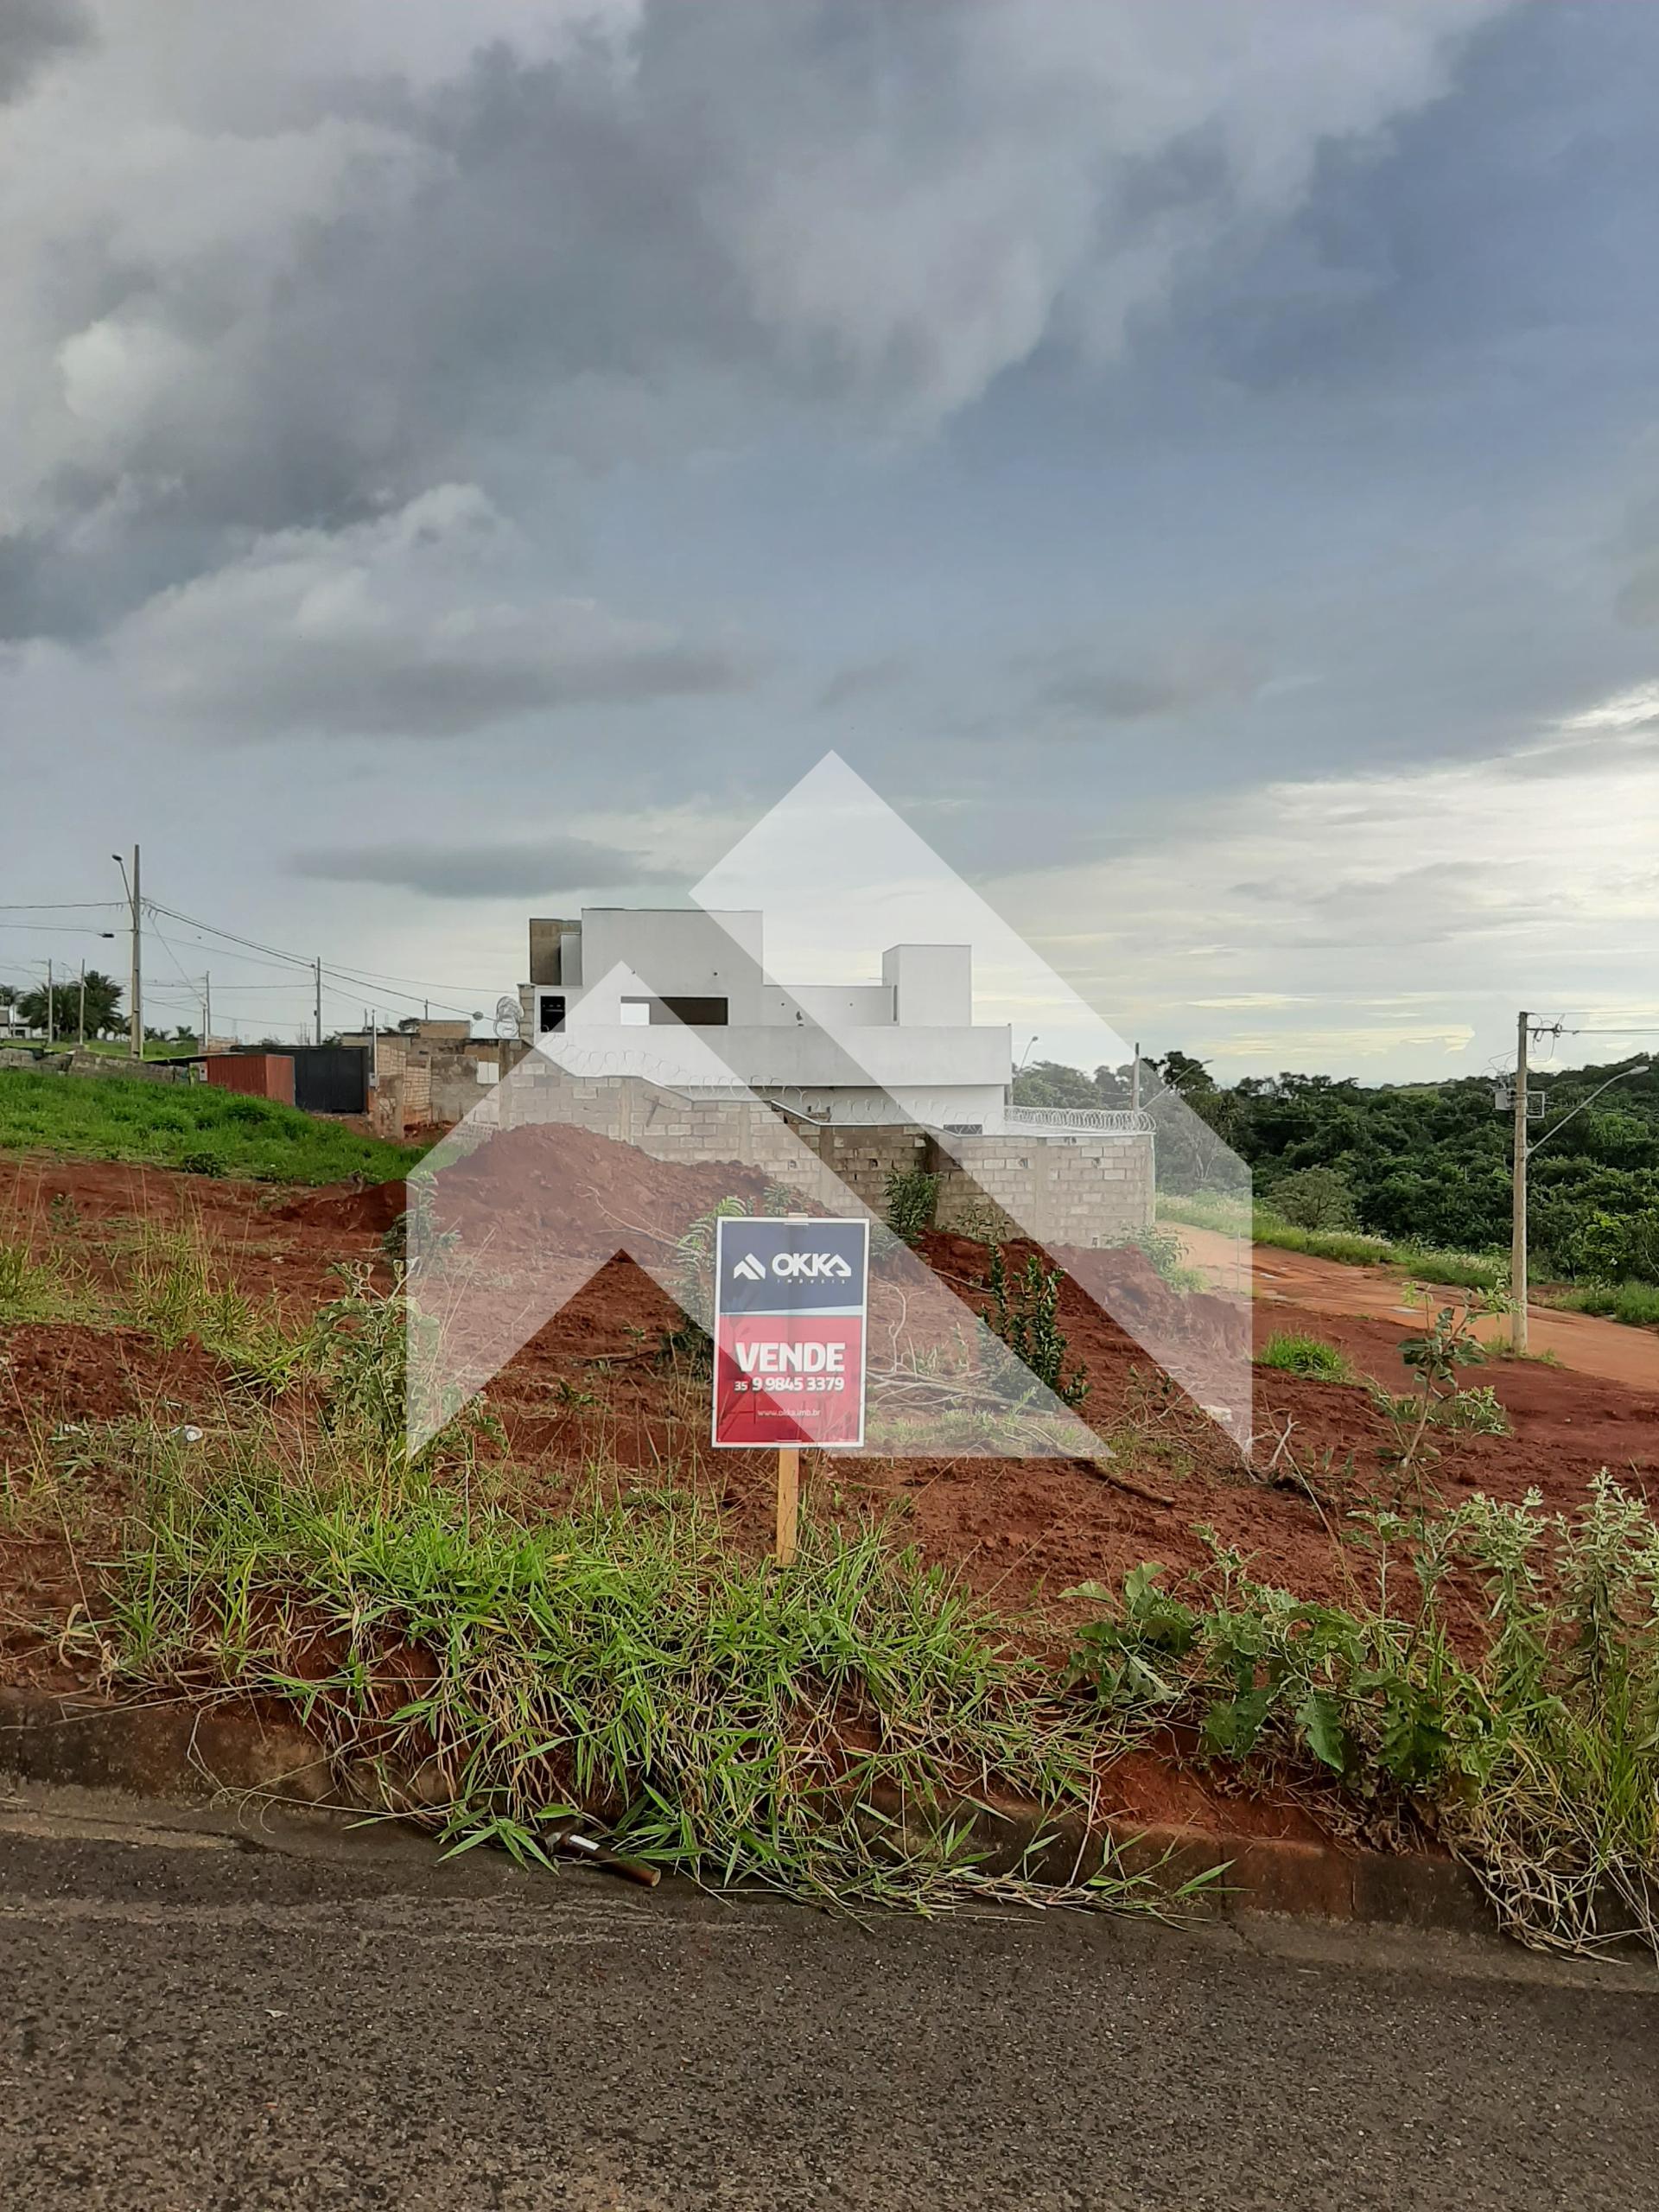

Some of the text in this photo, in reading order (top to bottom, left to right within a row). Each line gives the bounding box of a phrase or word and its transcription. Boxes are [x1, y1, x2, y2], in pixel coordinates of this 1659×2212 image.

[772, 1253, 851, 1277] OKKA
[735, 1342, 845, 1372] VENDE
[734, 1376, 844, 1391] 35 9 9845 3379
